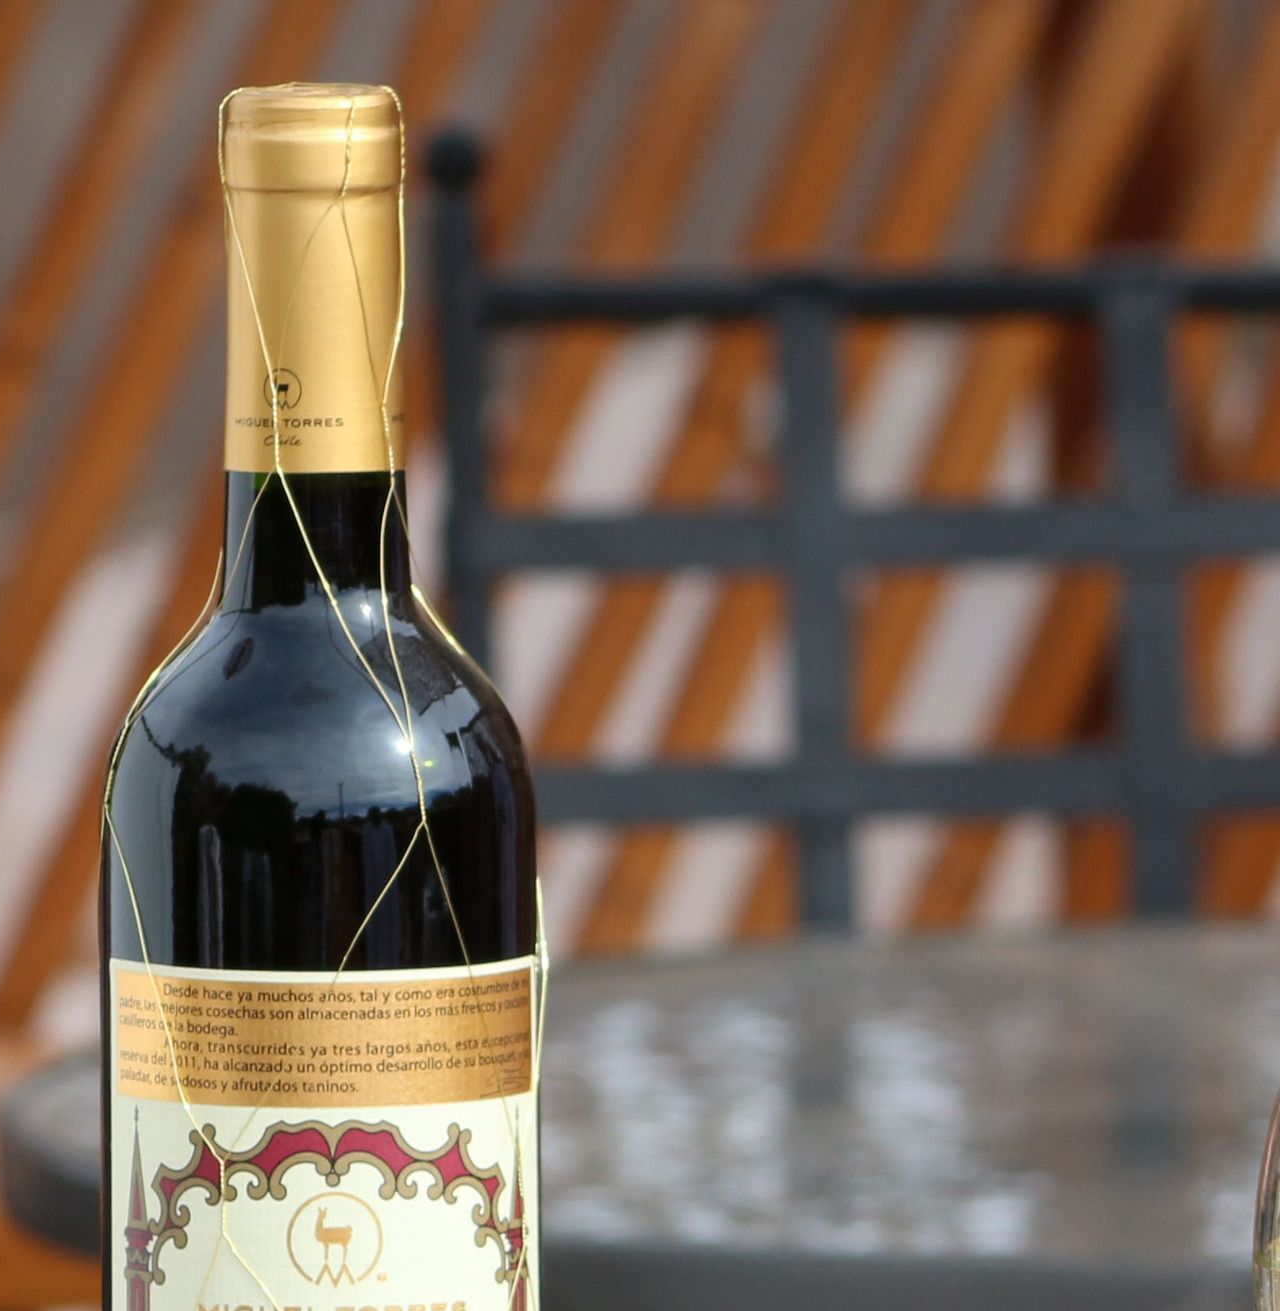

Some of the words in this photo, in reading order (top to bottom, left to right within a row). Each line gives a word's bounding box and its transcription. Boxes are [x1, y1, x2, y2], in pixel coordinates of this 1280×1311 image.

[284, 417, 344, 429] TORRES
[163, 983, 199, 999] Desde
[203, 985, 233, 1001] hace
[238, 991, 253, 1005] ya
[257, 988, 314, 1003] muchos
[319, 989, 356, 1004] años,
[360, 988, 377, 1003] tal
[382, 991, 390, 1005] y
[395, 989, 432, 1001] como
[436, 987, 455, 1000] era
[458, 980, 509, 998] costumbre
[160, 1001, 203, 1017] mejores
[206, 1005, 266, 1020] cosechas
[269, 1008, 294, 1020] son
[297, 1006, 391, 1020] almacenadas
[394, 1008, 411, 1019] en
[414, 1004, 432, 1018] los
[435, 1002, 459, 1017] más
[461, 1000, 496, 1015] frescos
[174, 1019, 184, 1032] la
[187, 1022, 239, 1039] bodega.
[164, 1035, 203, 1054] Ahora,
[207, 1041, 305, 1056] transcurridos
[310, 1045, 327, 1058] ya
[332, 1044, 361, 1056] tres
[366, 1041, 411, 1058] largos
[416, 1040, 451, 1054] años,
[455, 1038, 478, 1051] esta
[151, 1051, 167, 1066] del
[203, 1056, 219, 1071] ha
[222, 1058, 293, 1073] alcanzado
[297, 1062, 315, 1073] un
[320, 1060, 372, 1076] óptimo
[376, 1057, 443, 1073] desarrollo
[446, 1055, 461, 1069] de
[464, 1056, 475, 1068] su
[154, 1072, 167, 1086] de
[171, 1074, 217, 1089] sdosos
[220, 1080, 228, 1093] y
[231, 1077, 298, 1093] afrutados
[302, 1079, 360, 1093] taninos.
